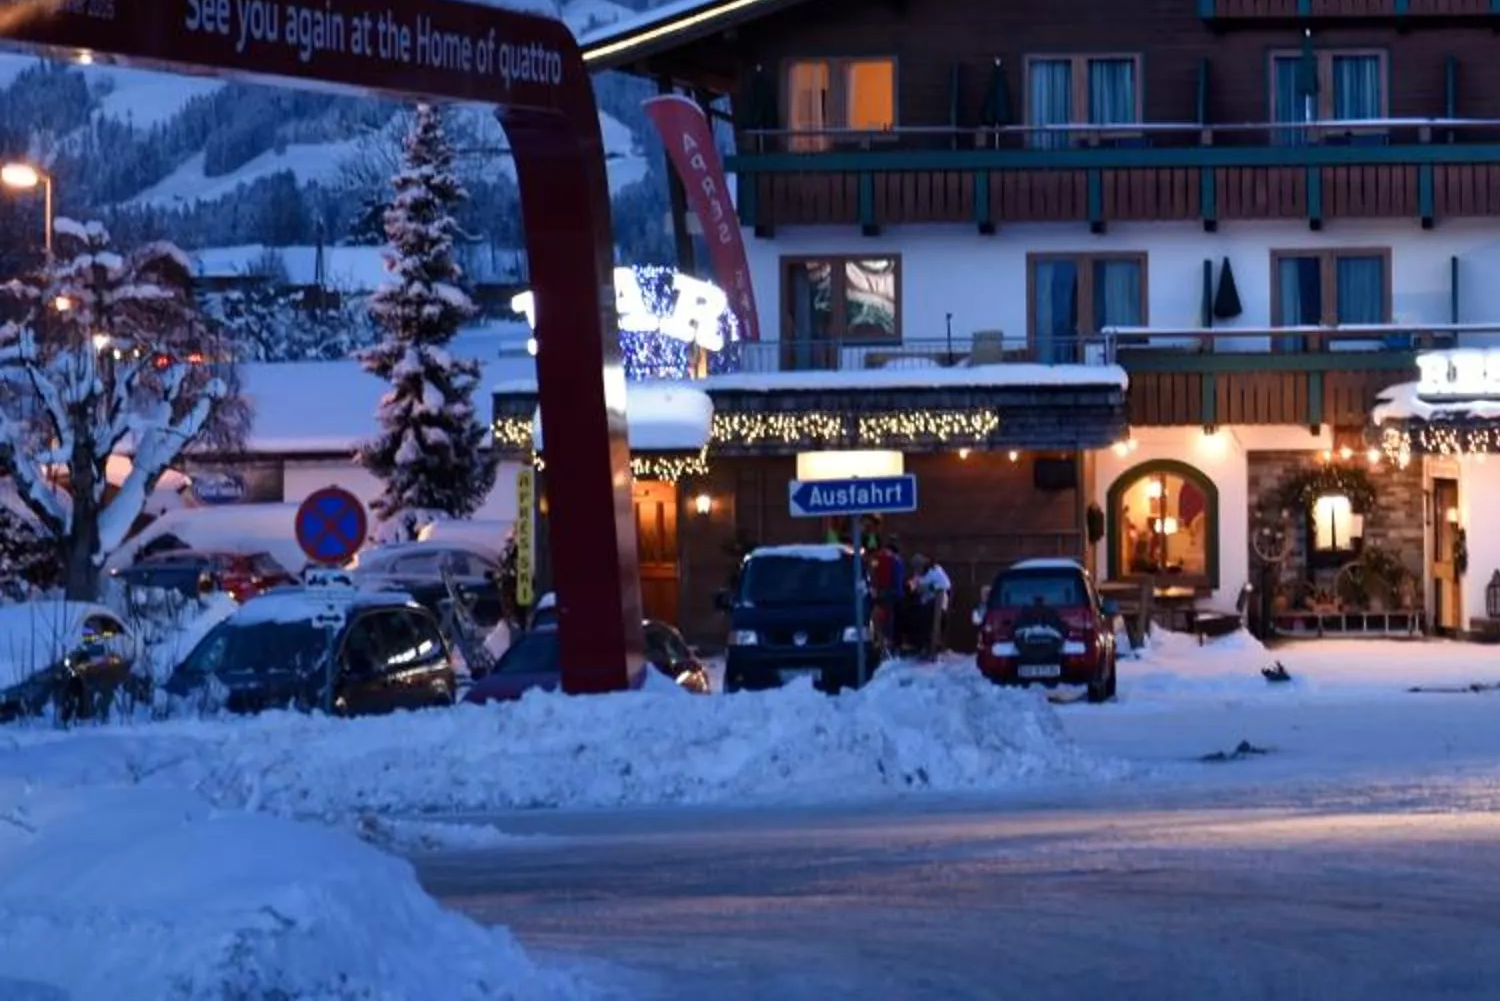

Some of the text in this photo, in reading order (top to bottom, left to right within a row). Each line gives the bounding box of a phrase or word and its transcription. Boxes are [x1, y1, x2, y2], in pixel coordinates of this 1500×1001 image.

[351, 11, 374, 57] at
[377, 8, 412, 63] the
[416, 13, 473, 72] Home
[475, 27, 496, 75] of
[499, 41, 563, 91] quattro
[808, 481, 903, 507] Ausfahrt
